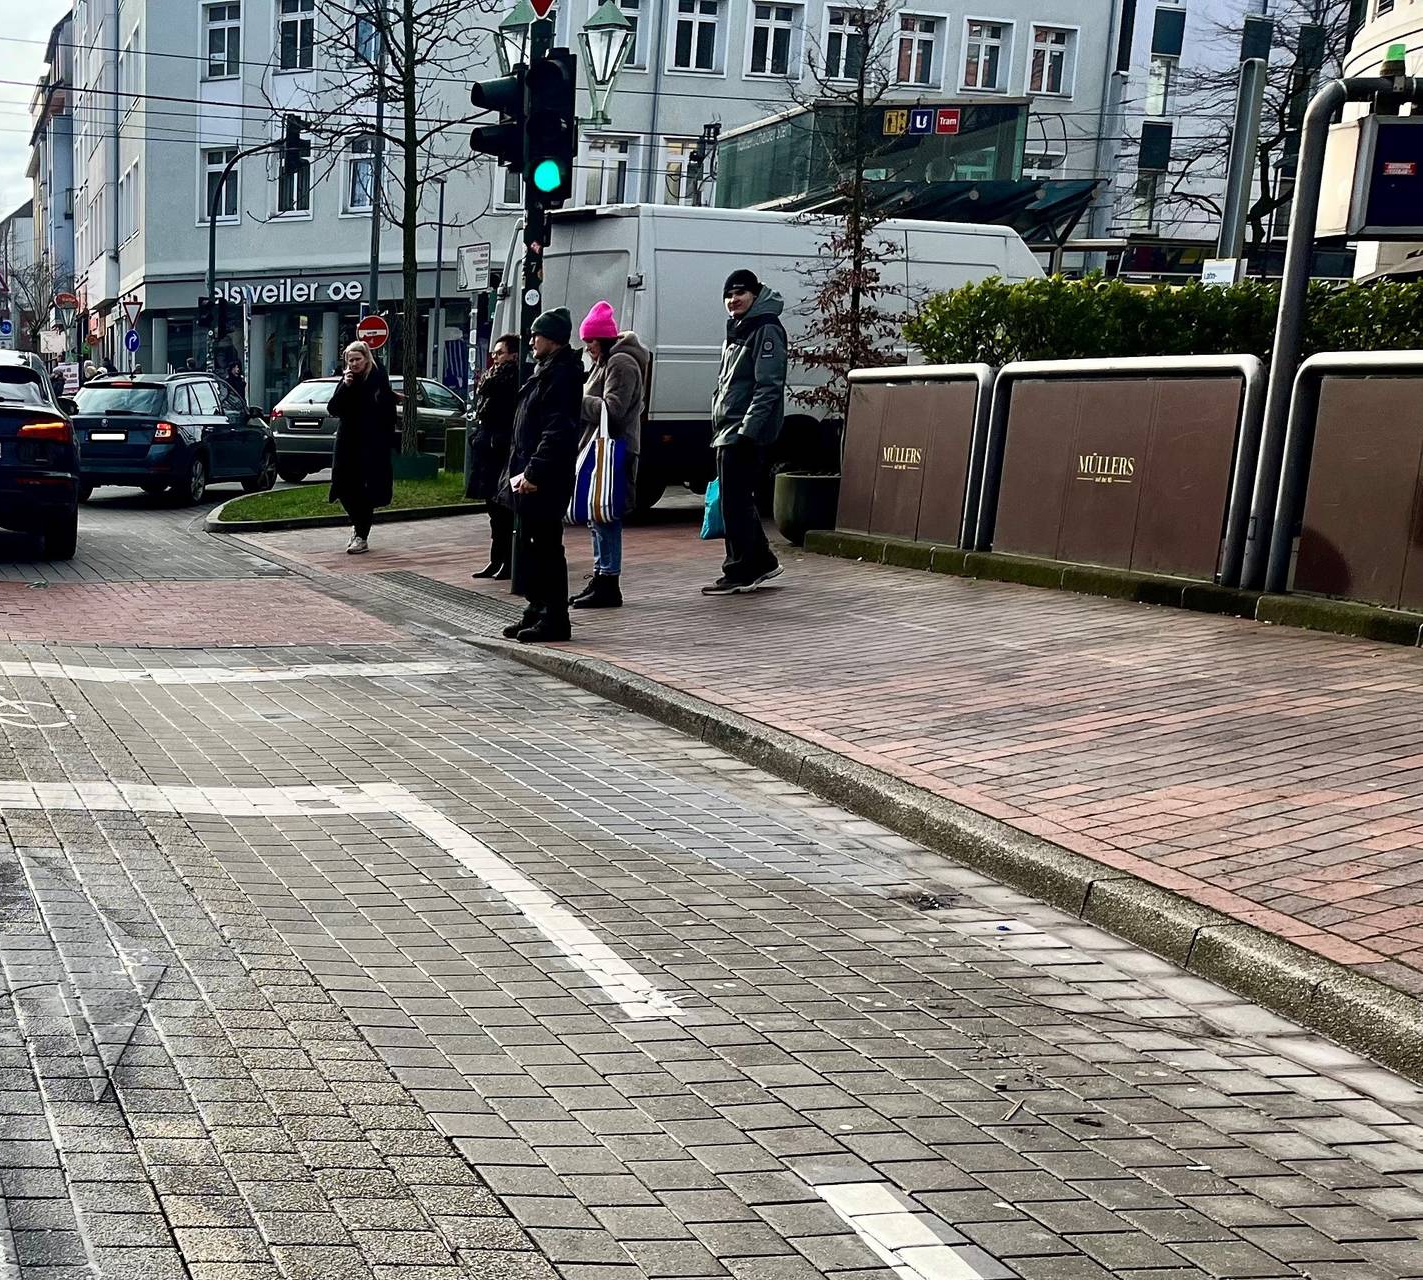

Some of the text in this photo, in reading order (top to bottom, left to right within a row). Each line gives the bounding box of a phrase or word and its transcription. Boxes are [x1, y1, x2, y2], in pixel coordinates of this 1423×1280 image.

[939, 116, 957, 126] Tram
[882, 444, 922, 465] MÜLLERS
[1078, 452, 1135, 476] MÜLLERS
